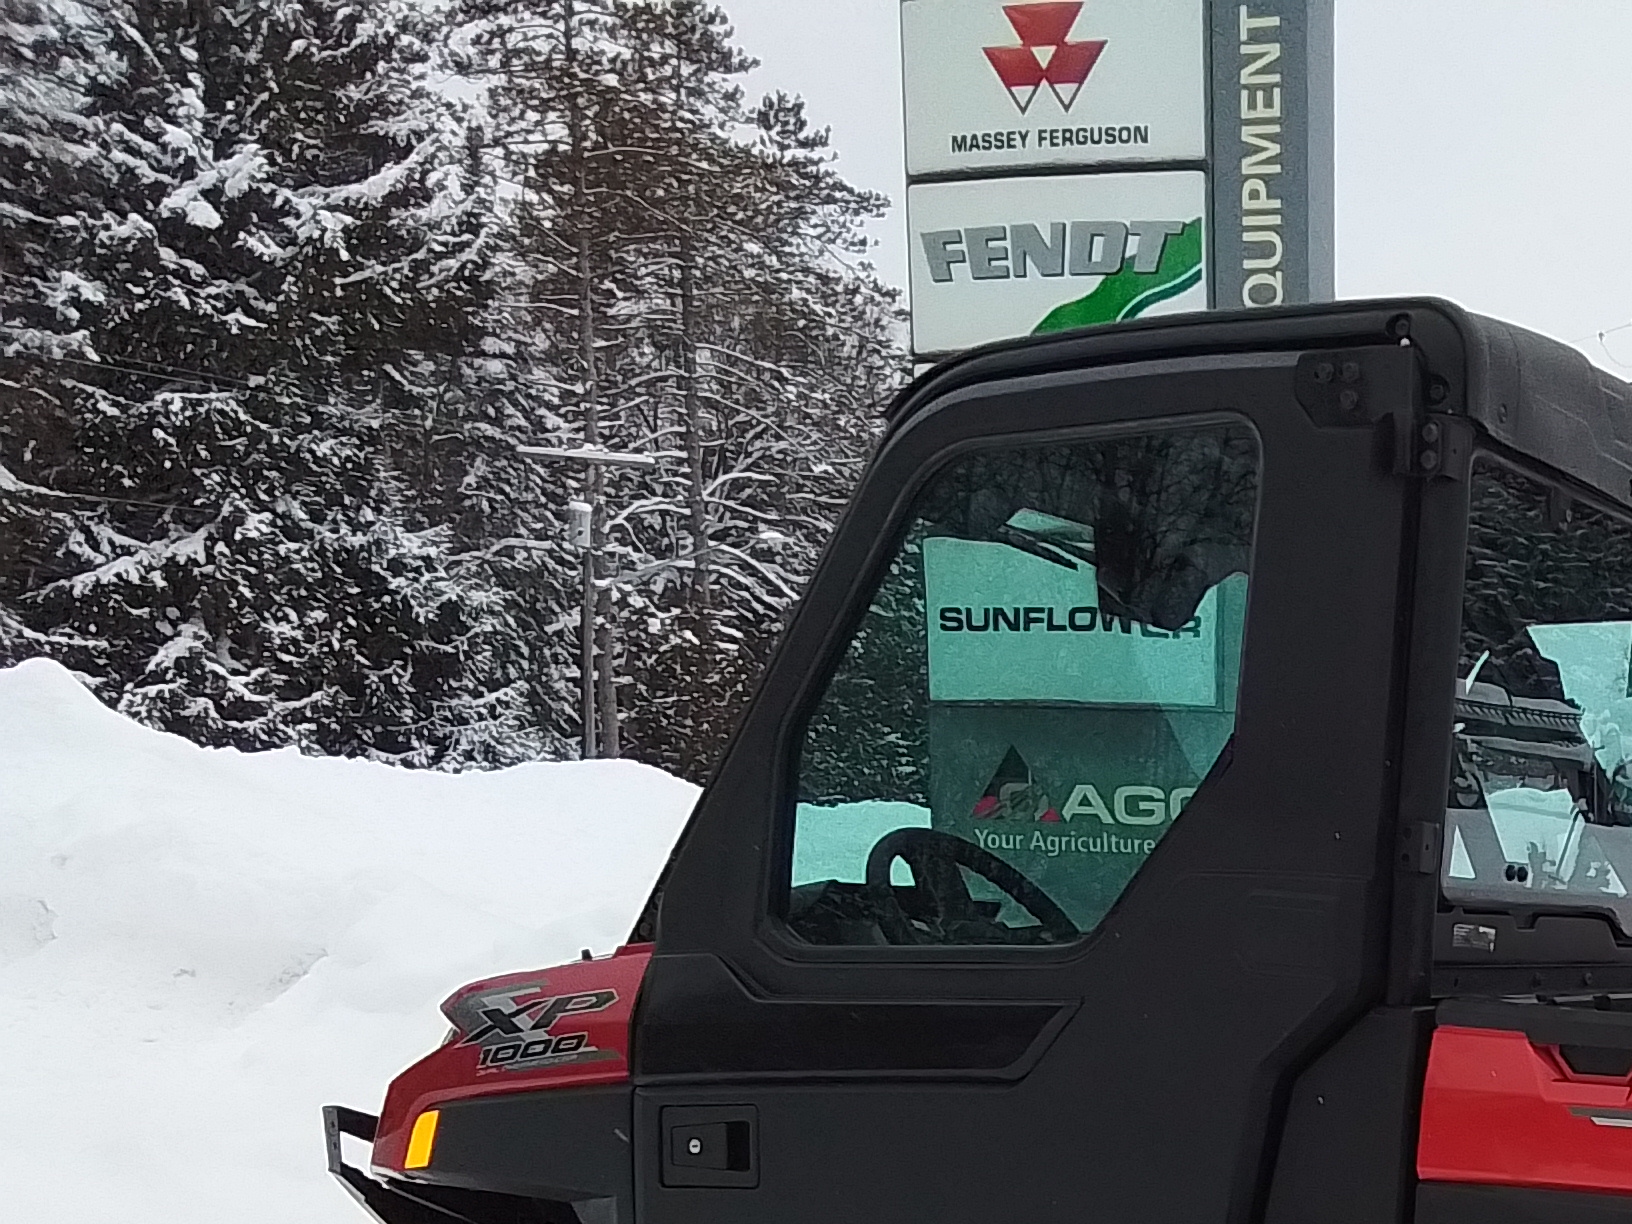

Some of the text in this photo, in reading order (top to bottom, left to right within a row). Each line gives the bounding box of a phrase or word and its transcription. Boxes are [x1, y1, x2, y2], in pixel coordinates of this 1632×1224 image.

[950, 125, 1150, 153] MASSEY FERGUSON
[920, 220, 1185, 283] FENDT
[973, 828, 1156, 857] Your Agriculture
[457, 989, 619, 1048] XP
[477, 1031, 588, 1070] 1000
